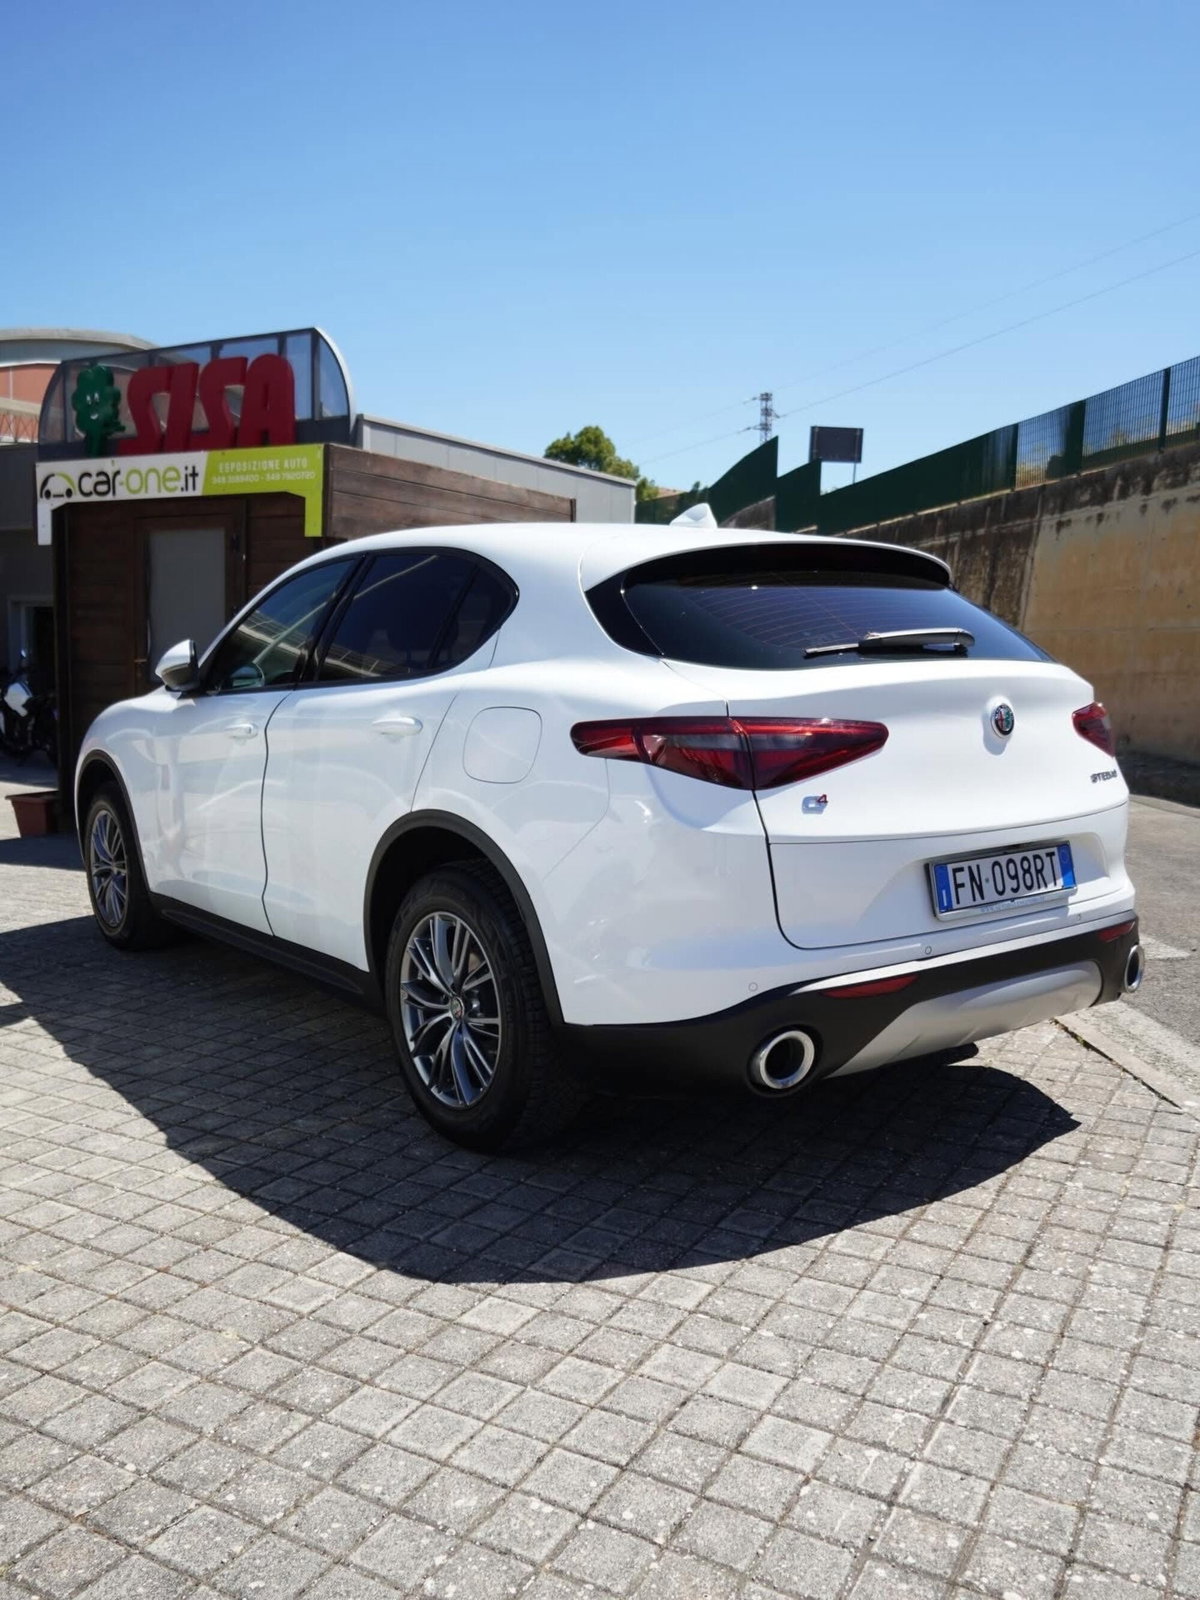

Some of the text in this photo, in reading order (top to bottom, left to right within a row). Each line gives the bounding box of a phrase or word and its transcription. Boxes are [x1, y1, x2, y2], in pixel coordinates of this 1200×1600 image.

[117, 353, 296, 454] SISA
[78, 465, 199, 497] car-one.it
[219, 457, 308, 473] ESPOSIZIONE AUTO
[952, 866, 985, 905] FN
[993, 851, 1057, 897] 098RT
